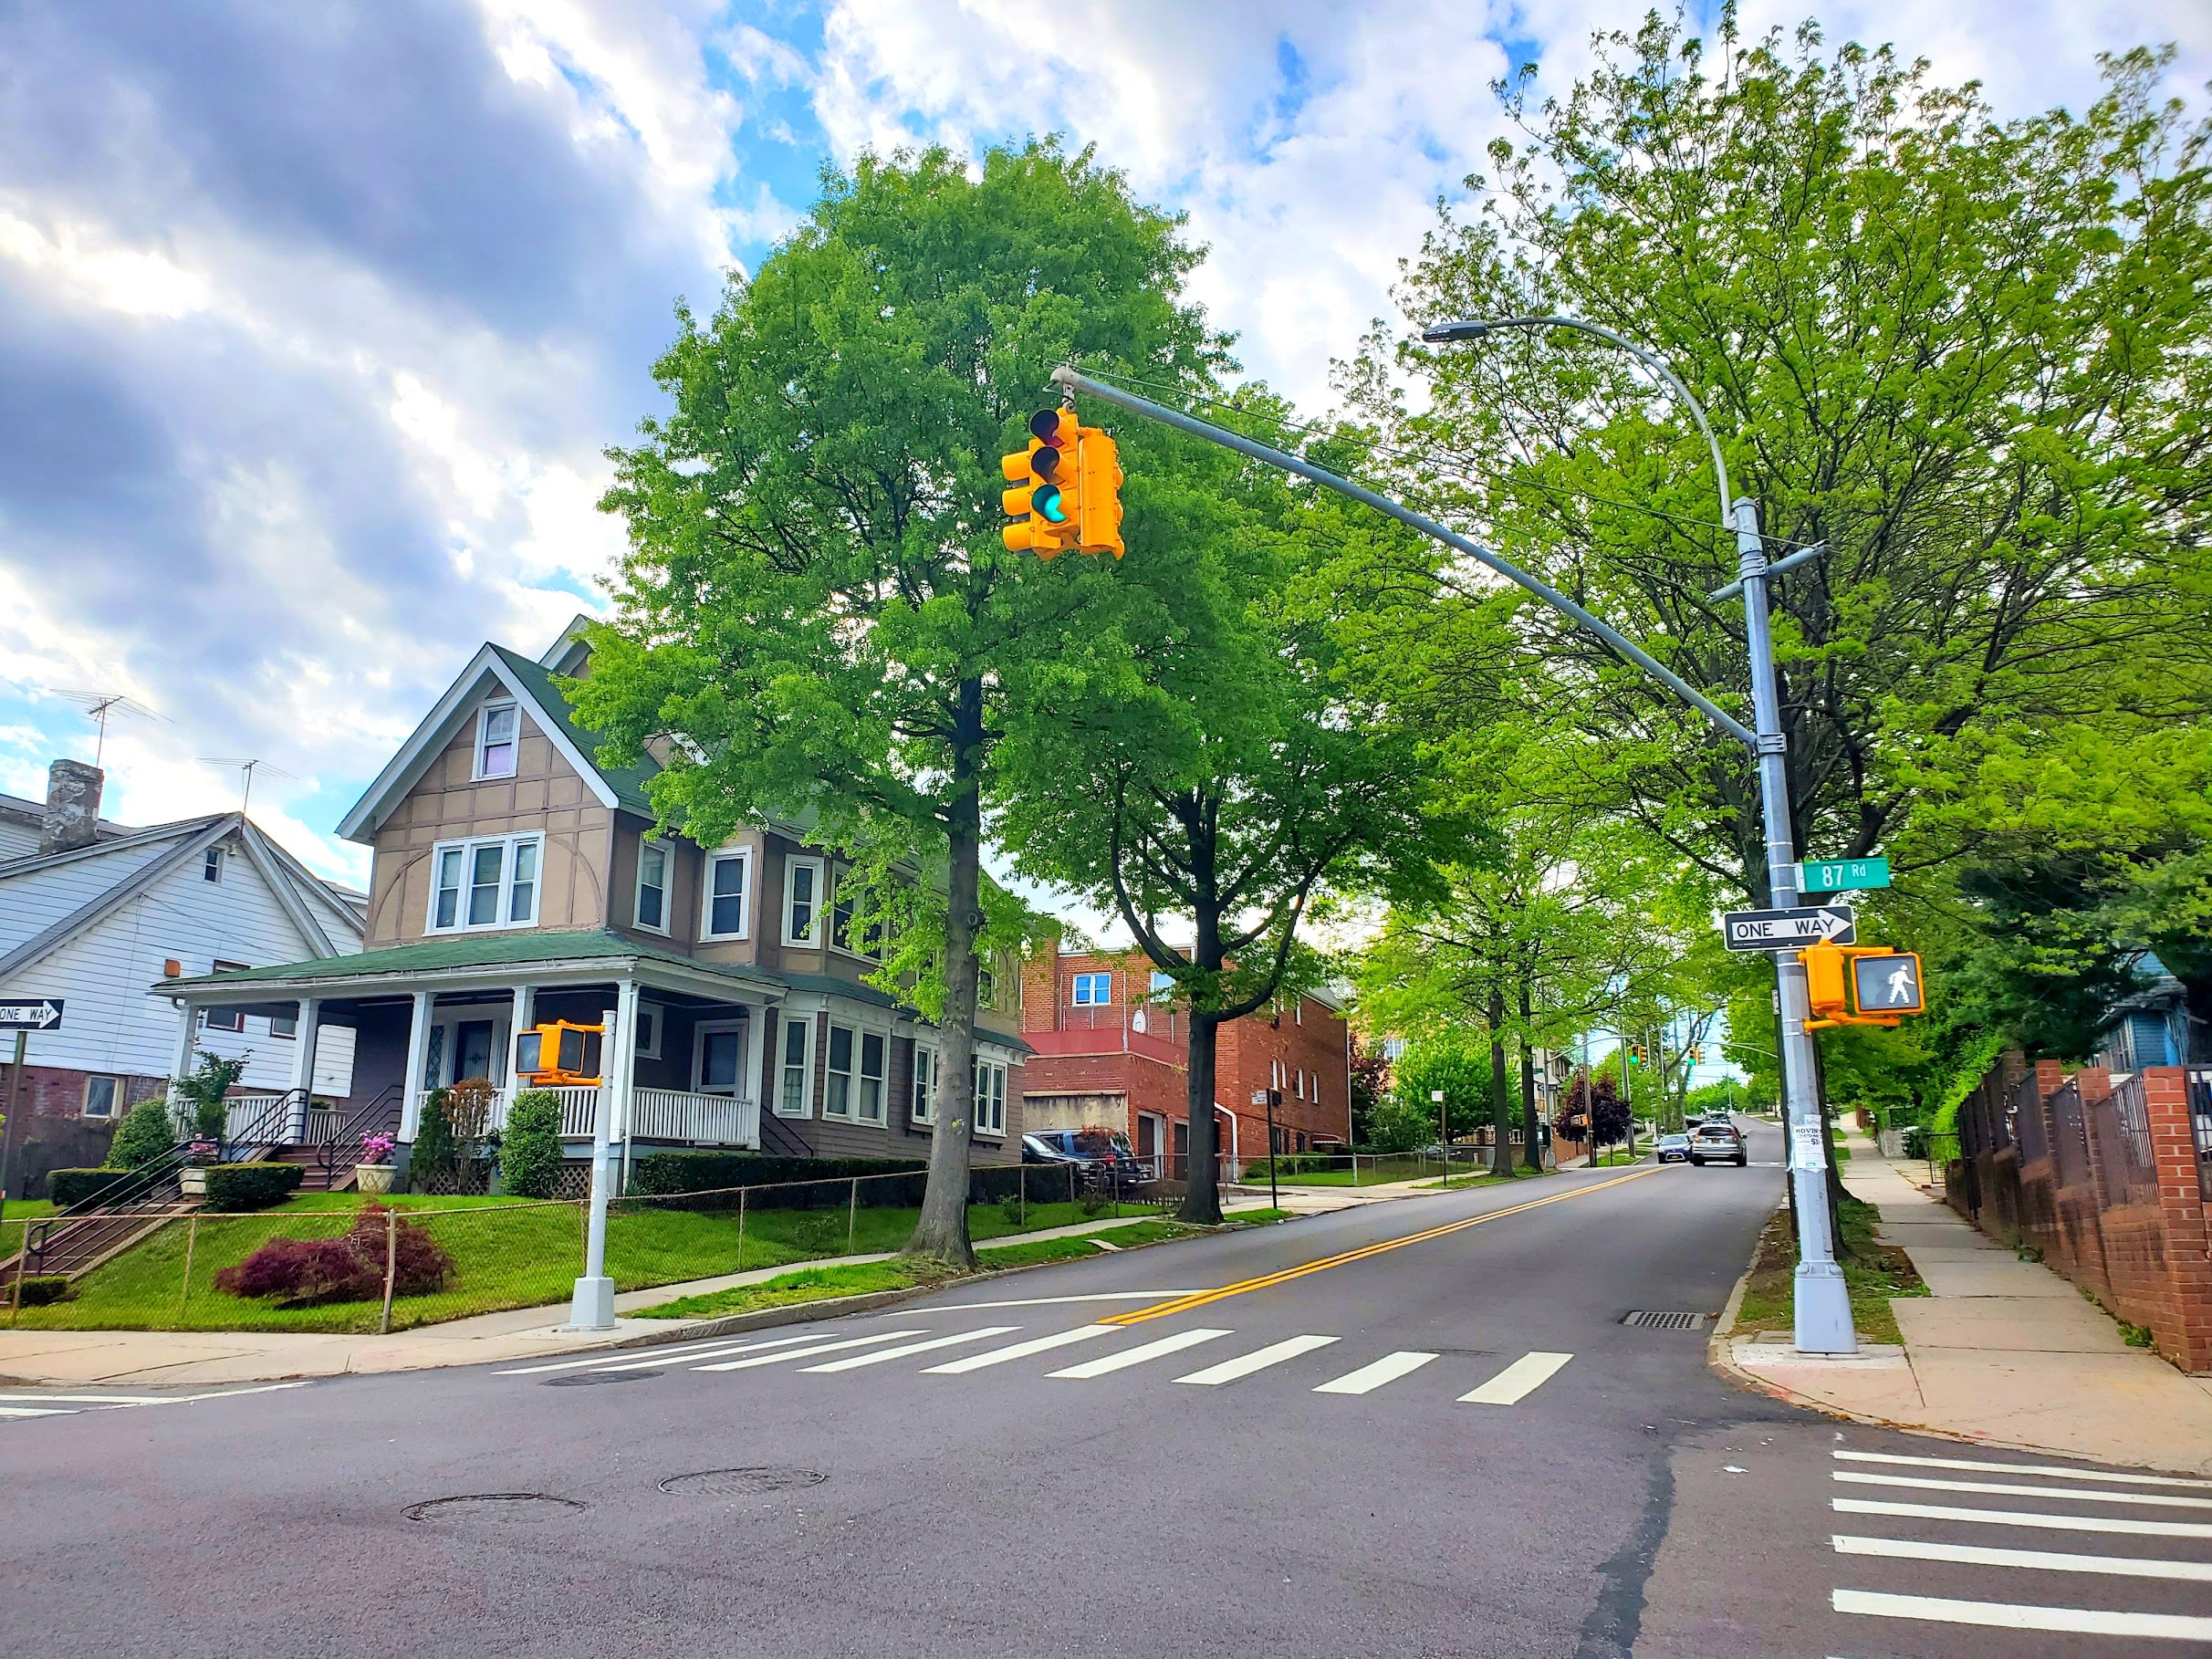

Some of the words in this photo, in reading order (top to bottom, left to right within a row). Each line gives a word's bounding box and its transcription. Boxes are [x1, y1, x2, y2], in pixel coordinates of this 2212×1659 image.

[1822, 865, 1843, 887] 87
[1852, 863, 1866, 877] Rd
[1737, 923, 1774, 938] ONE
[1794, 913, 1835, 934] WAY
[0, 1008, 21, 1020] ONE
[29, 1008, 53, 1020] WAY
